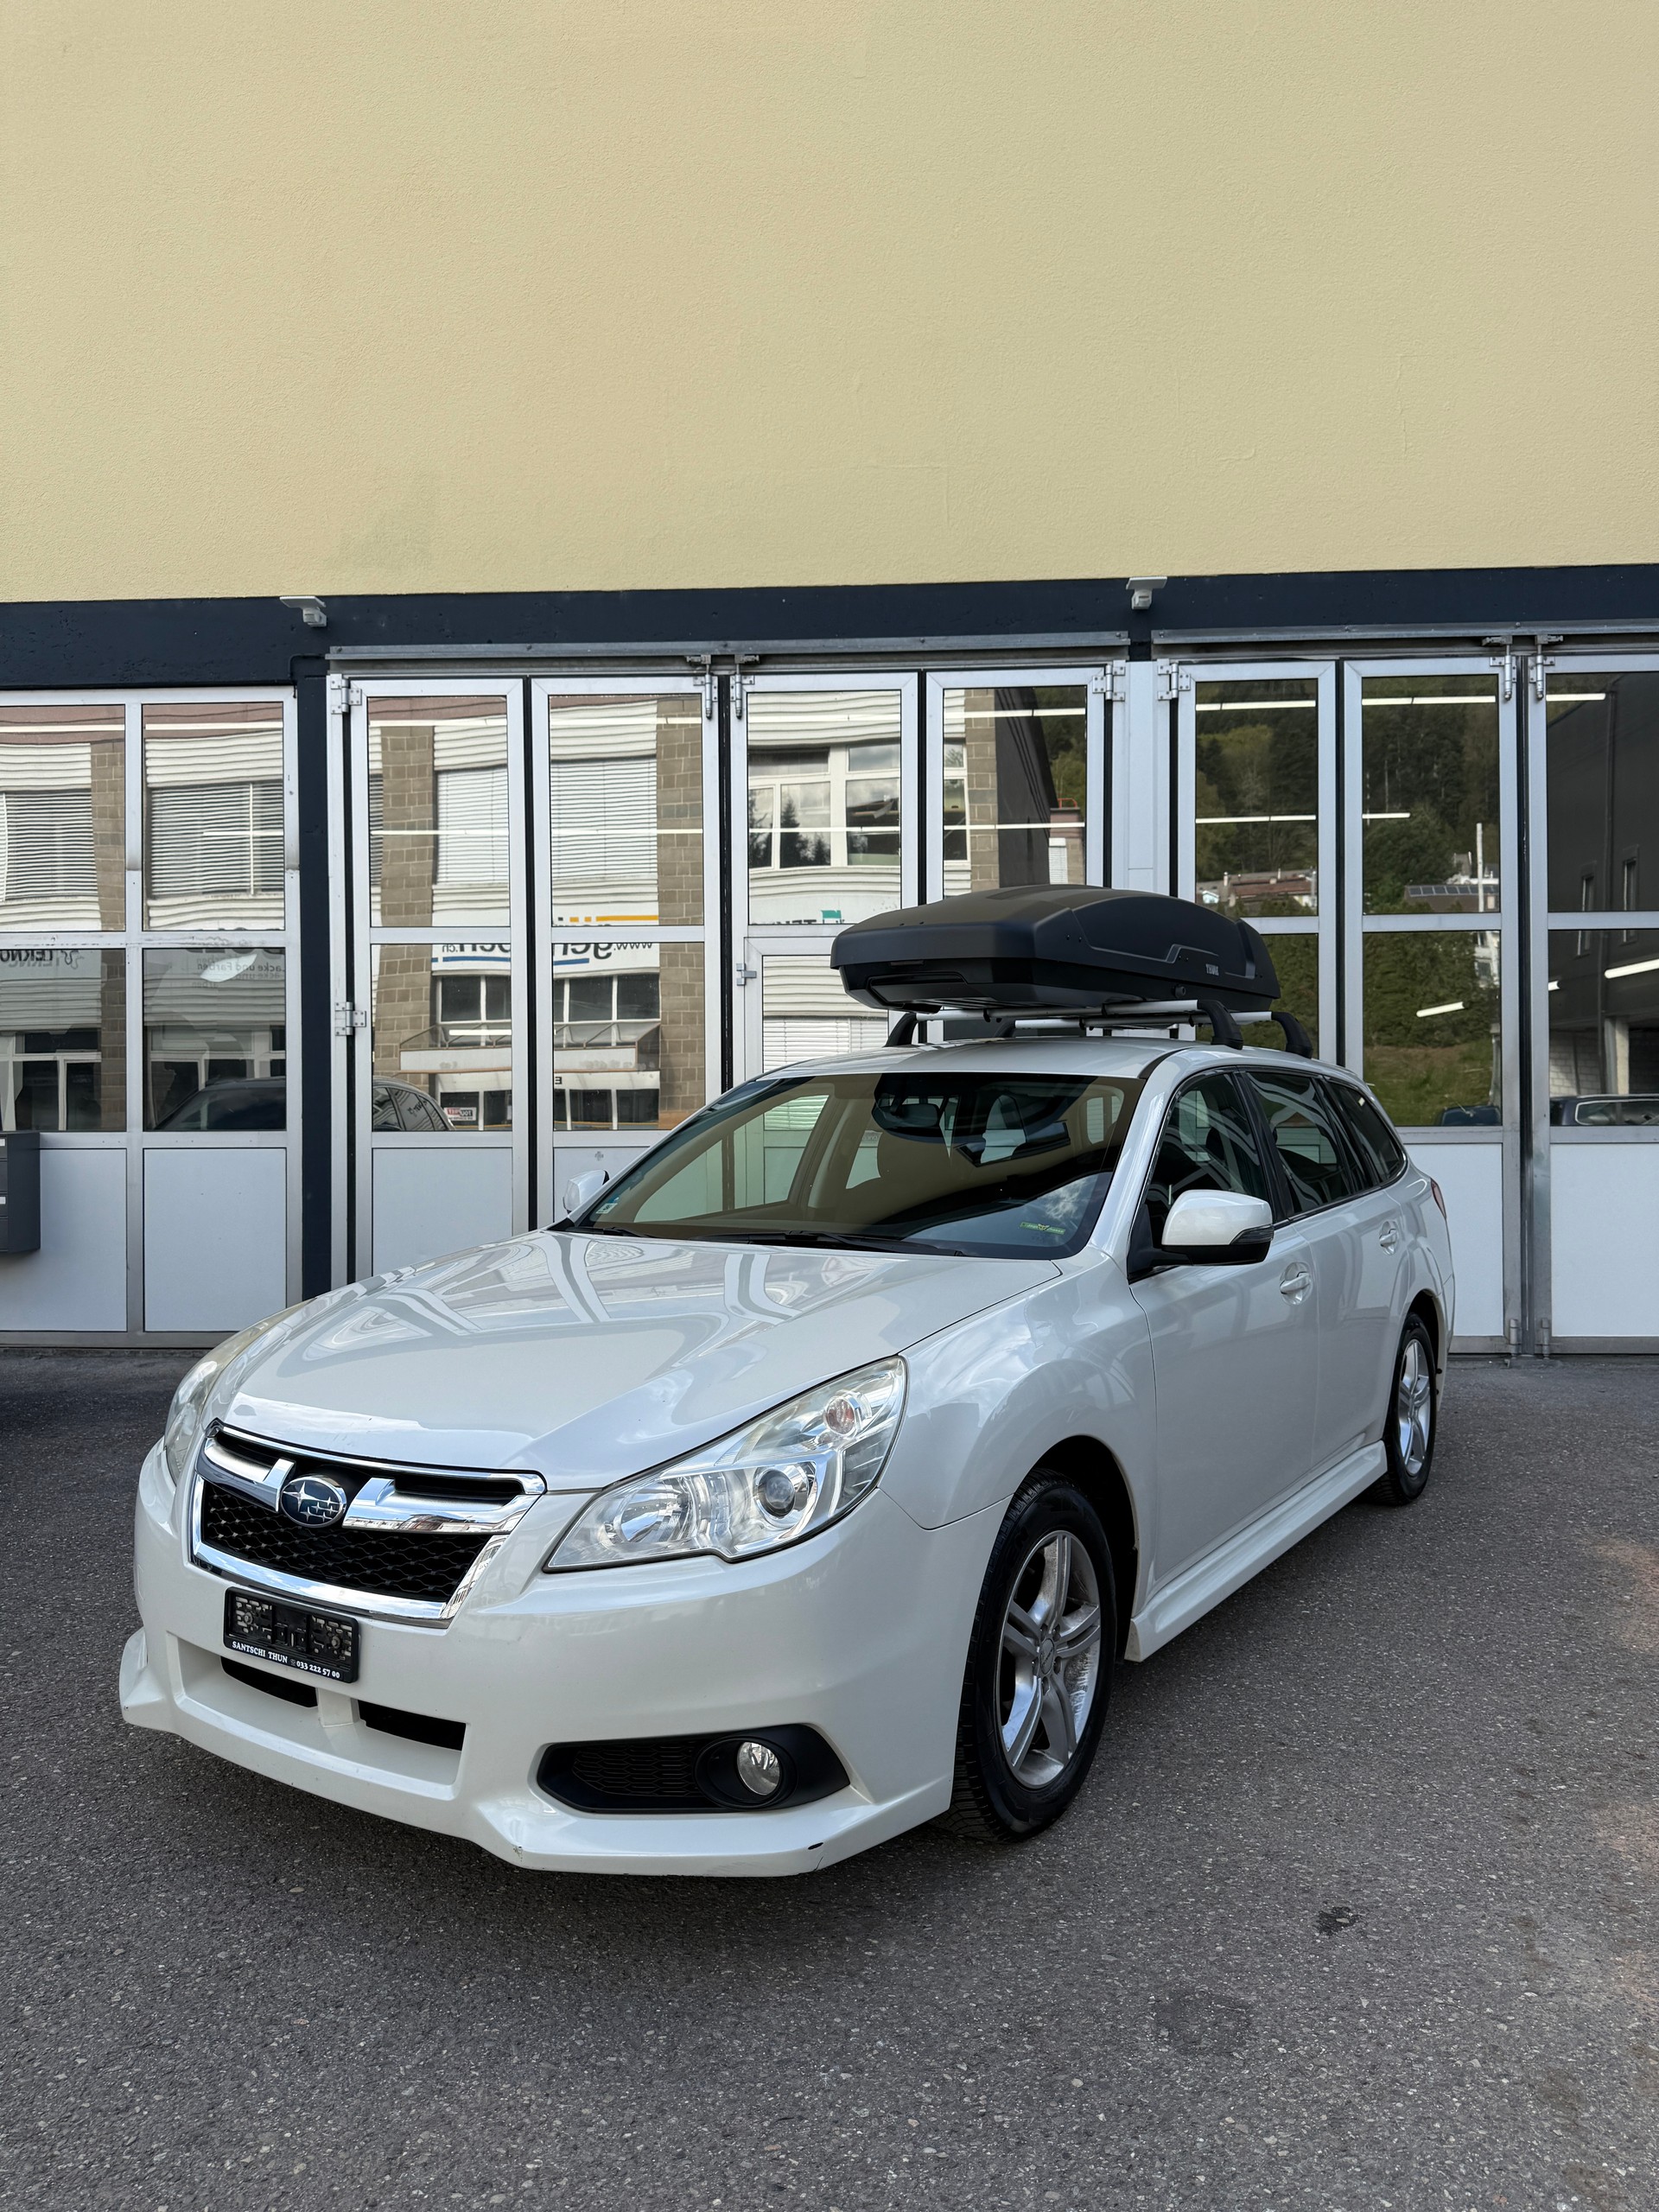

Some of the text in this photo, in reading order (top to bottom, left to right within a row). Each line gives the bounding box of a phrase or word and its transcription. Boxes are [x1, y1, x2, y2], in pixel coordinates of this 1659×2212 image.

[232, 1641, 266, 1657] SANTSCHI
[268, 1651, 288, 1663] THUN
[296, 1661, 308, 1670] 033
[309, 1664, 321, 1674] 222
[322, 1669, 331, 1677] 57
